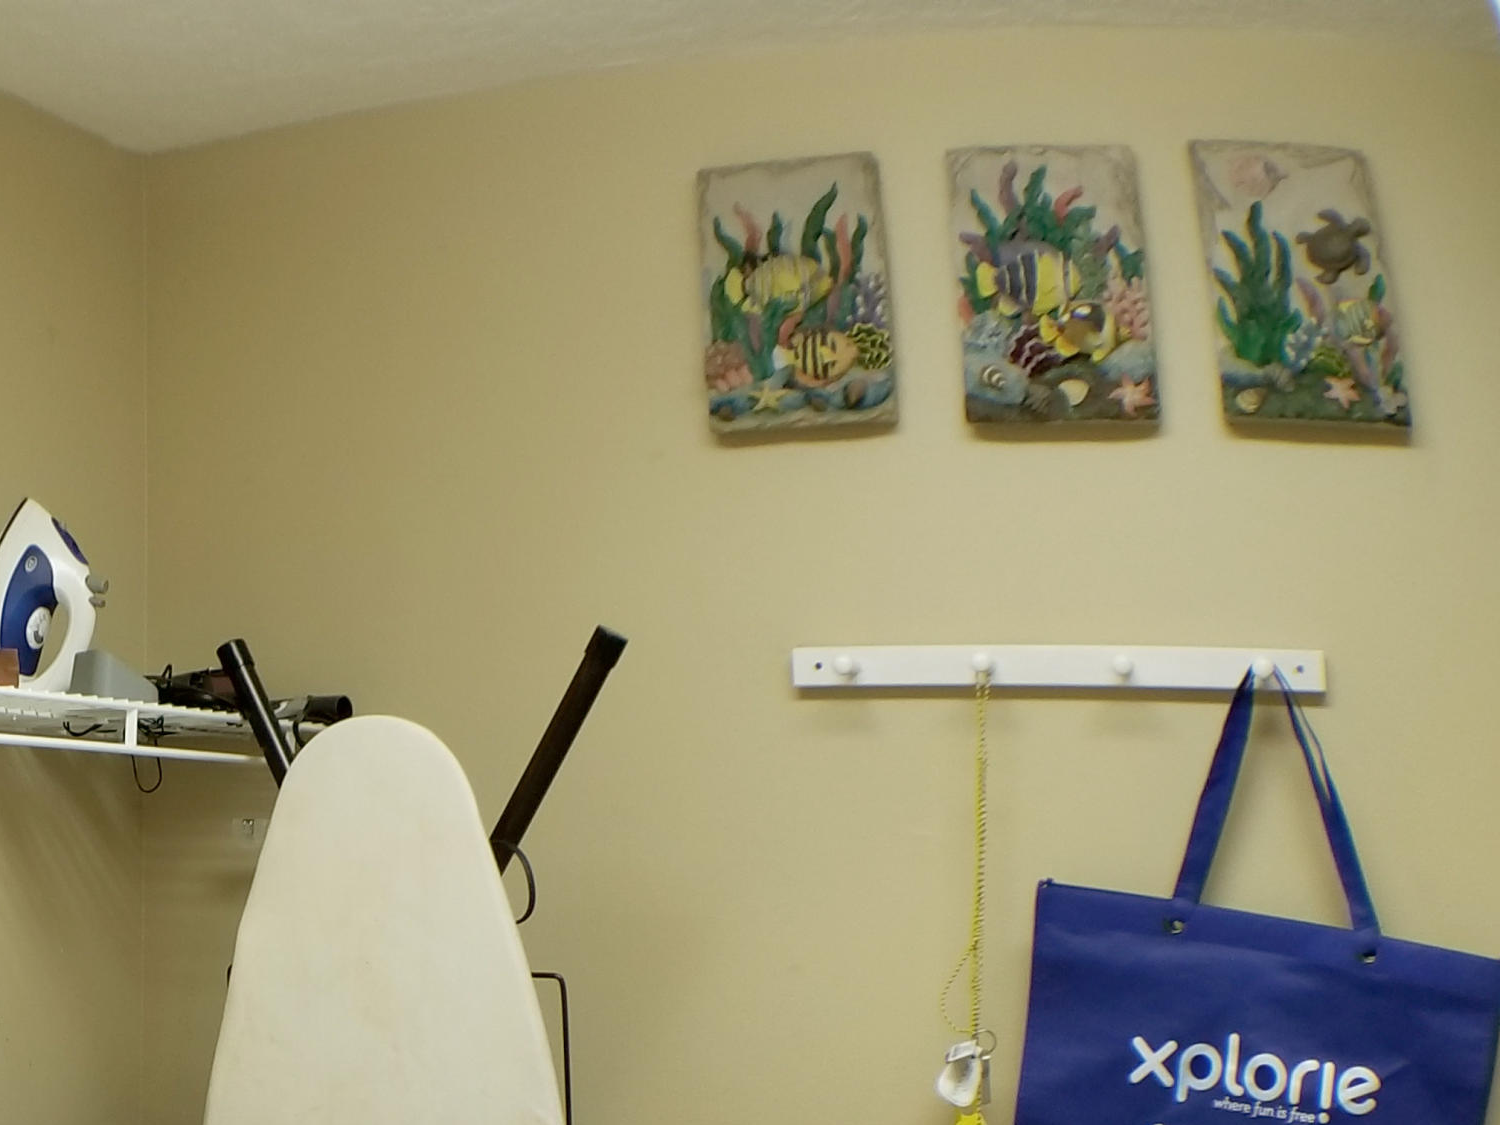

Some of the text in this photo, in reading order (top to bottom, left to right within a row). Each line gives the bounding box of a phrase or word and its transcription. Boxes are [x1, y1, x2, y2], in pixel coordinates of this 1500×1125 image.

[1213, 1096, 1316, 1123] where fun is free
